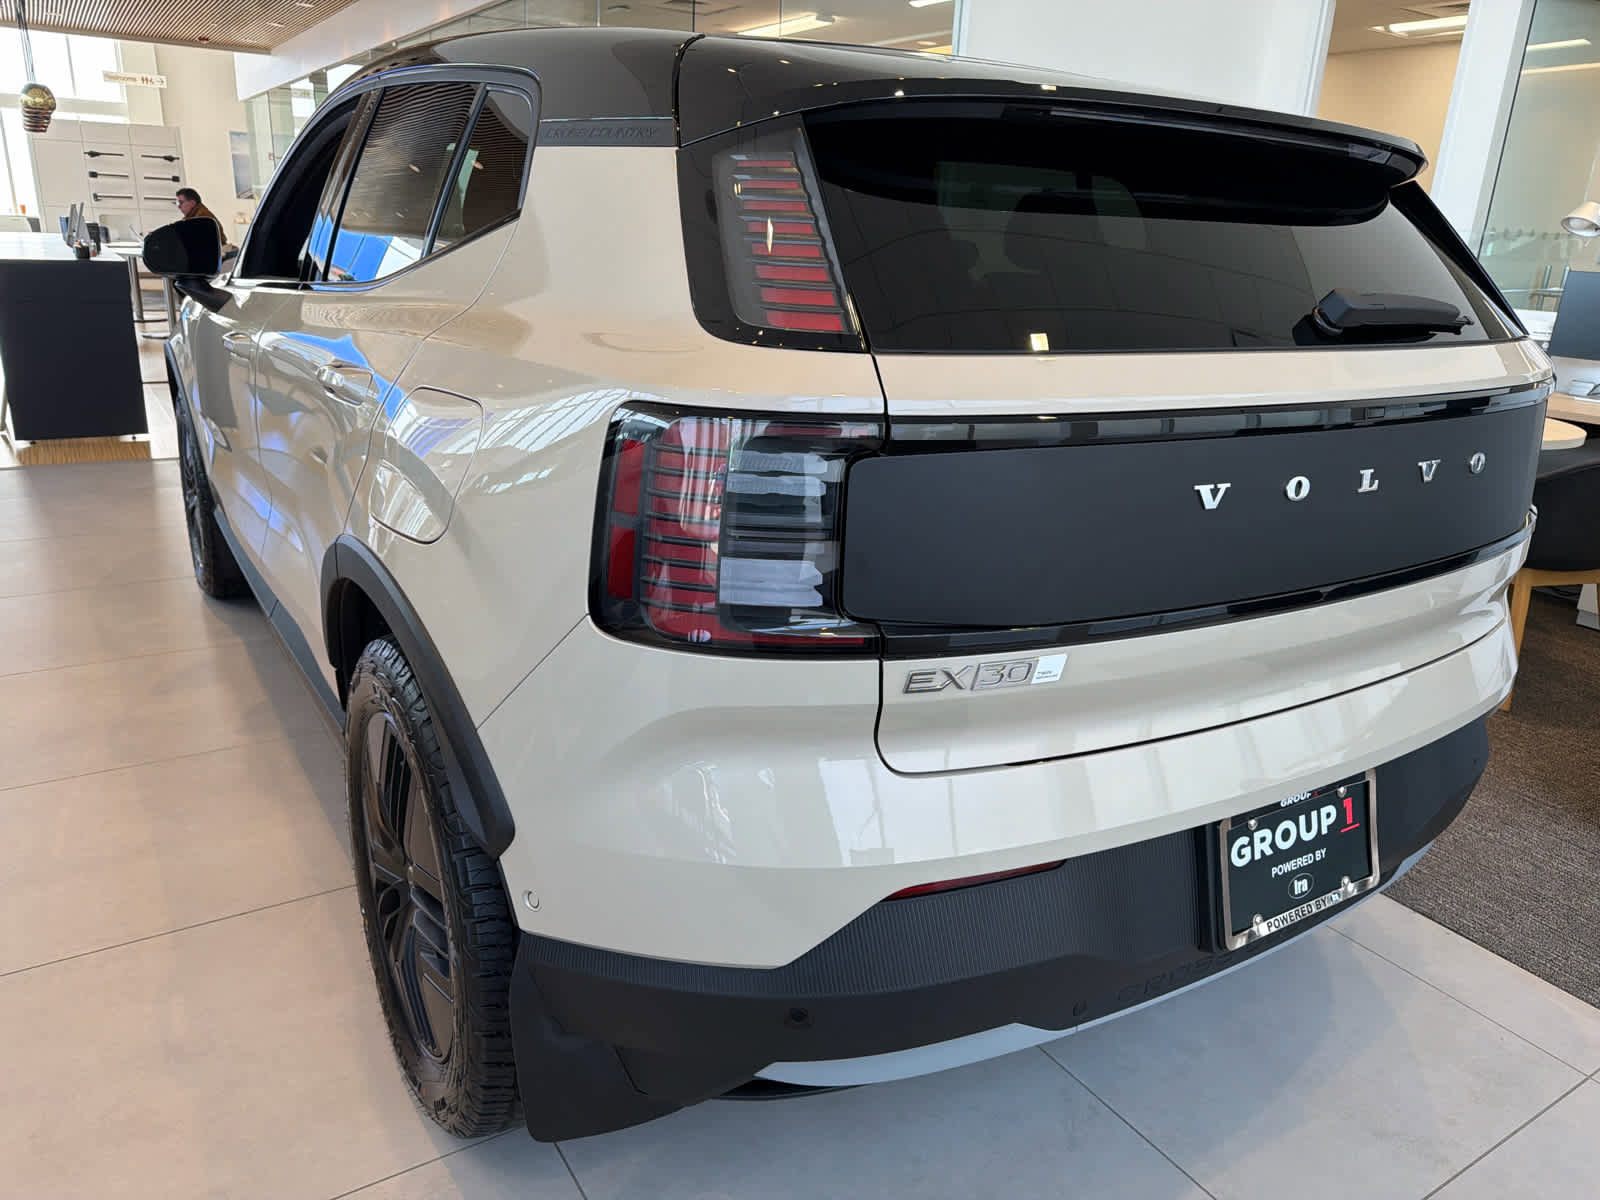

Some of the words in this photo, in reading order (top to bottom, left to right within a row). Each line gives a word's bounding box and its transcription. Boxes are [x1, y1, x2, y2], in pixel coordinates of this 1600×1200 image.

[1194, 452, 1486, 510] VOLVO
[1230, 804, 1337, 868] GROUP
[1271, 856, 1314, 878] POWERED
[1315, 848, 1327, 861] BY
[1266, 904, 1313, 932] POWERED
[1314, 895, 1328, 911] BY
